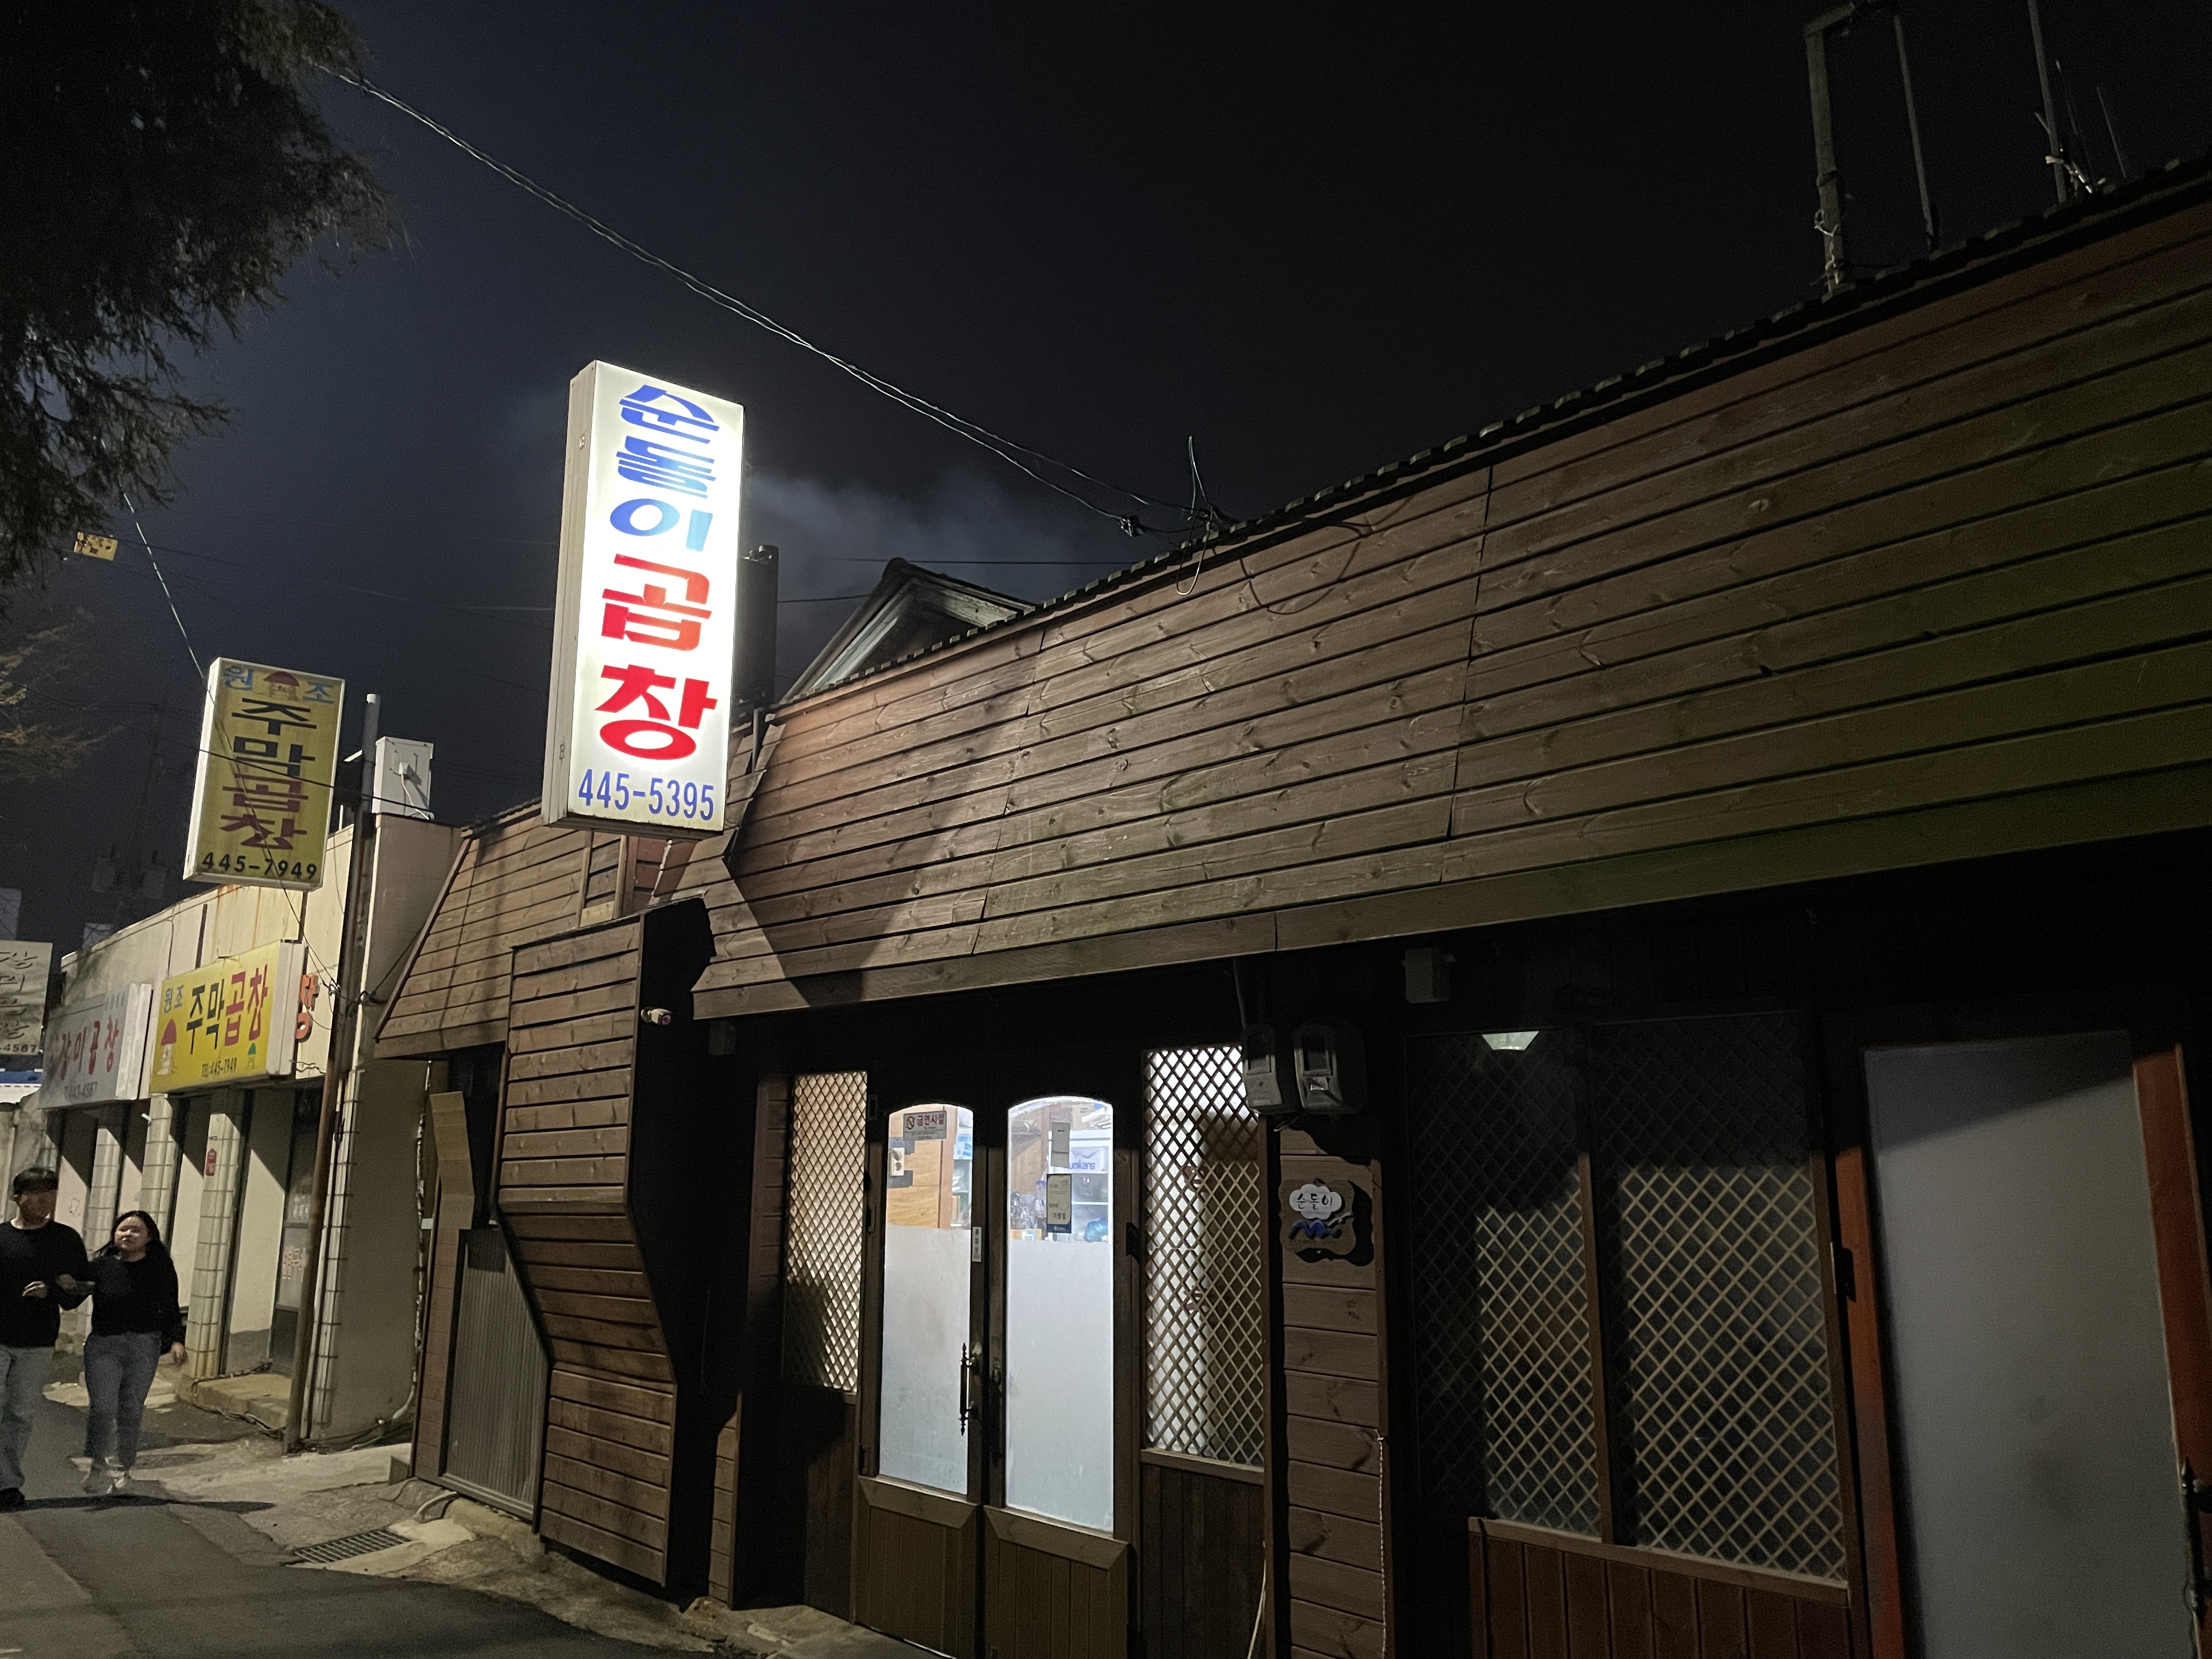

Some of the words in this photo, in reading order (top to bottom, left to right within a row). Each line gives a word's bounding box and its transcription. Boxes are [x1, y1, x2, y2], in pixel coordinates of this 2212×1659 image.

[578, 768, 715, 821] 445-5395
[202, 852, 318, 878] 445-7949
[163, 984, 185, 1014] 원조
[186, 964, 269, 1055] 주막곱창
[916, 1113, 944, 1126] 금연시설
[1296, 1193, 1333, 1210] 순돌이
